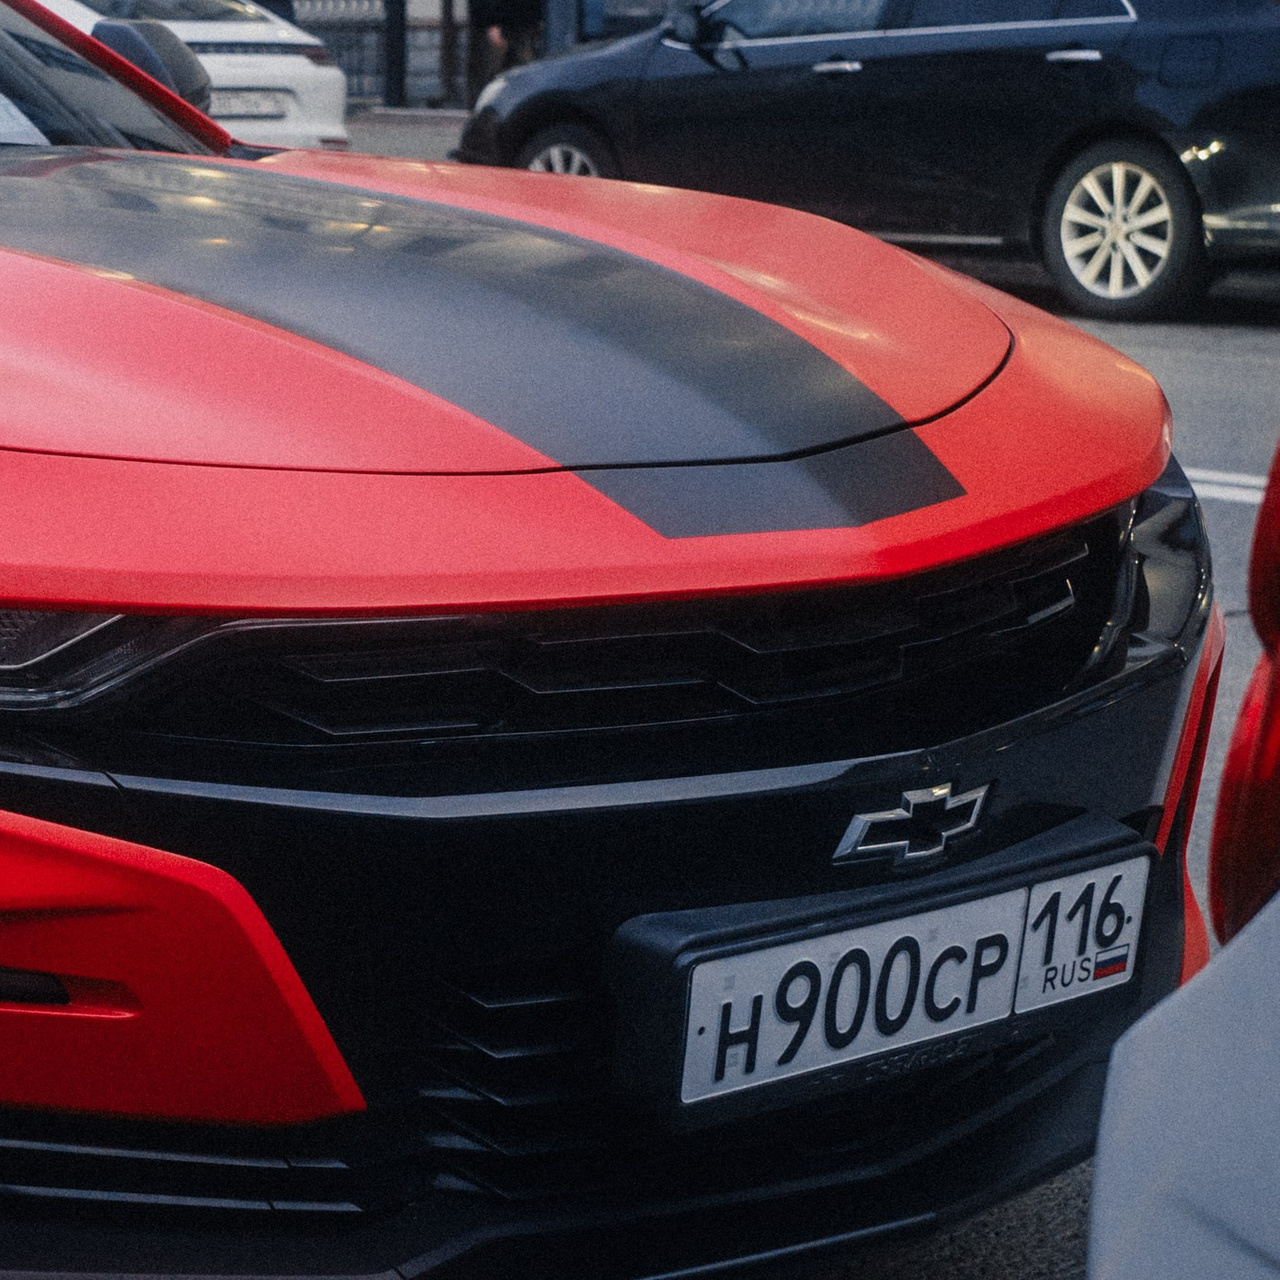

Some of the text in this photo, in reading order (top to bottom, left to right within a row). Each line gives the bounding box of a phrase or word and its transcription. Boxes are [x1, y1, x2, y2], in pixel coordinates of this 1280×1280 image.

[713, 874, 1126, 1083] Н900СР 116
[1042, 956, 1093, 994] RUS
